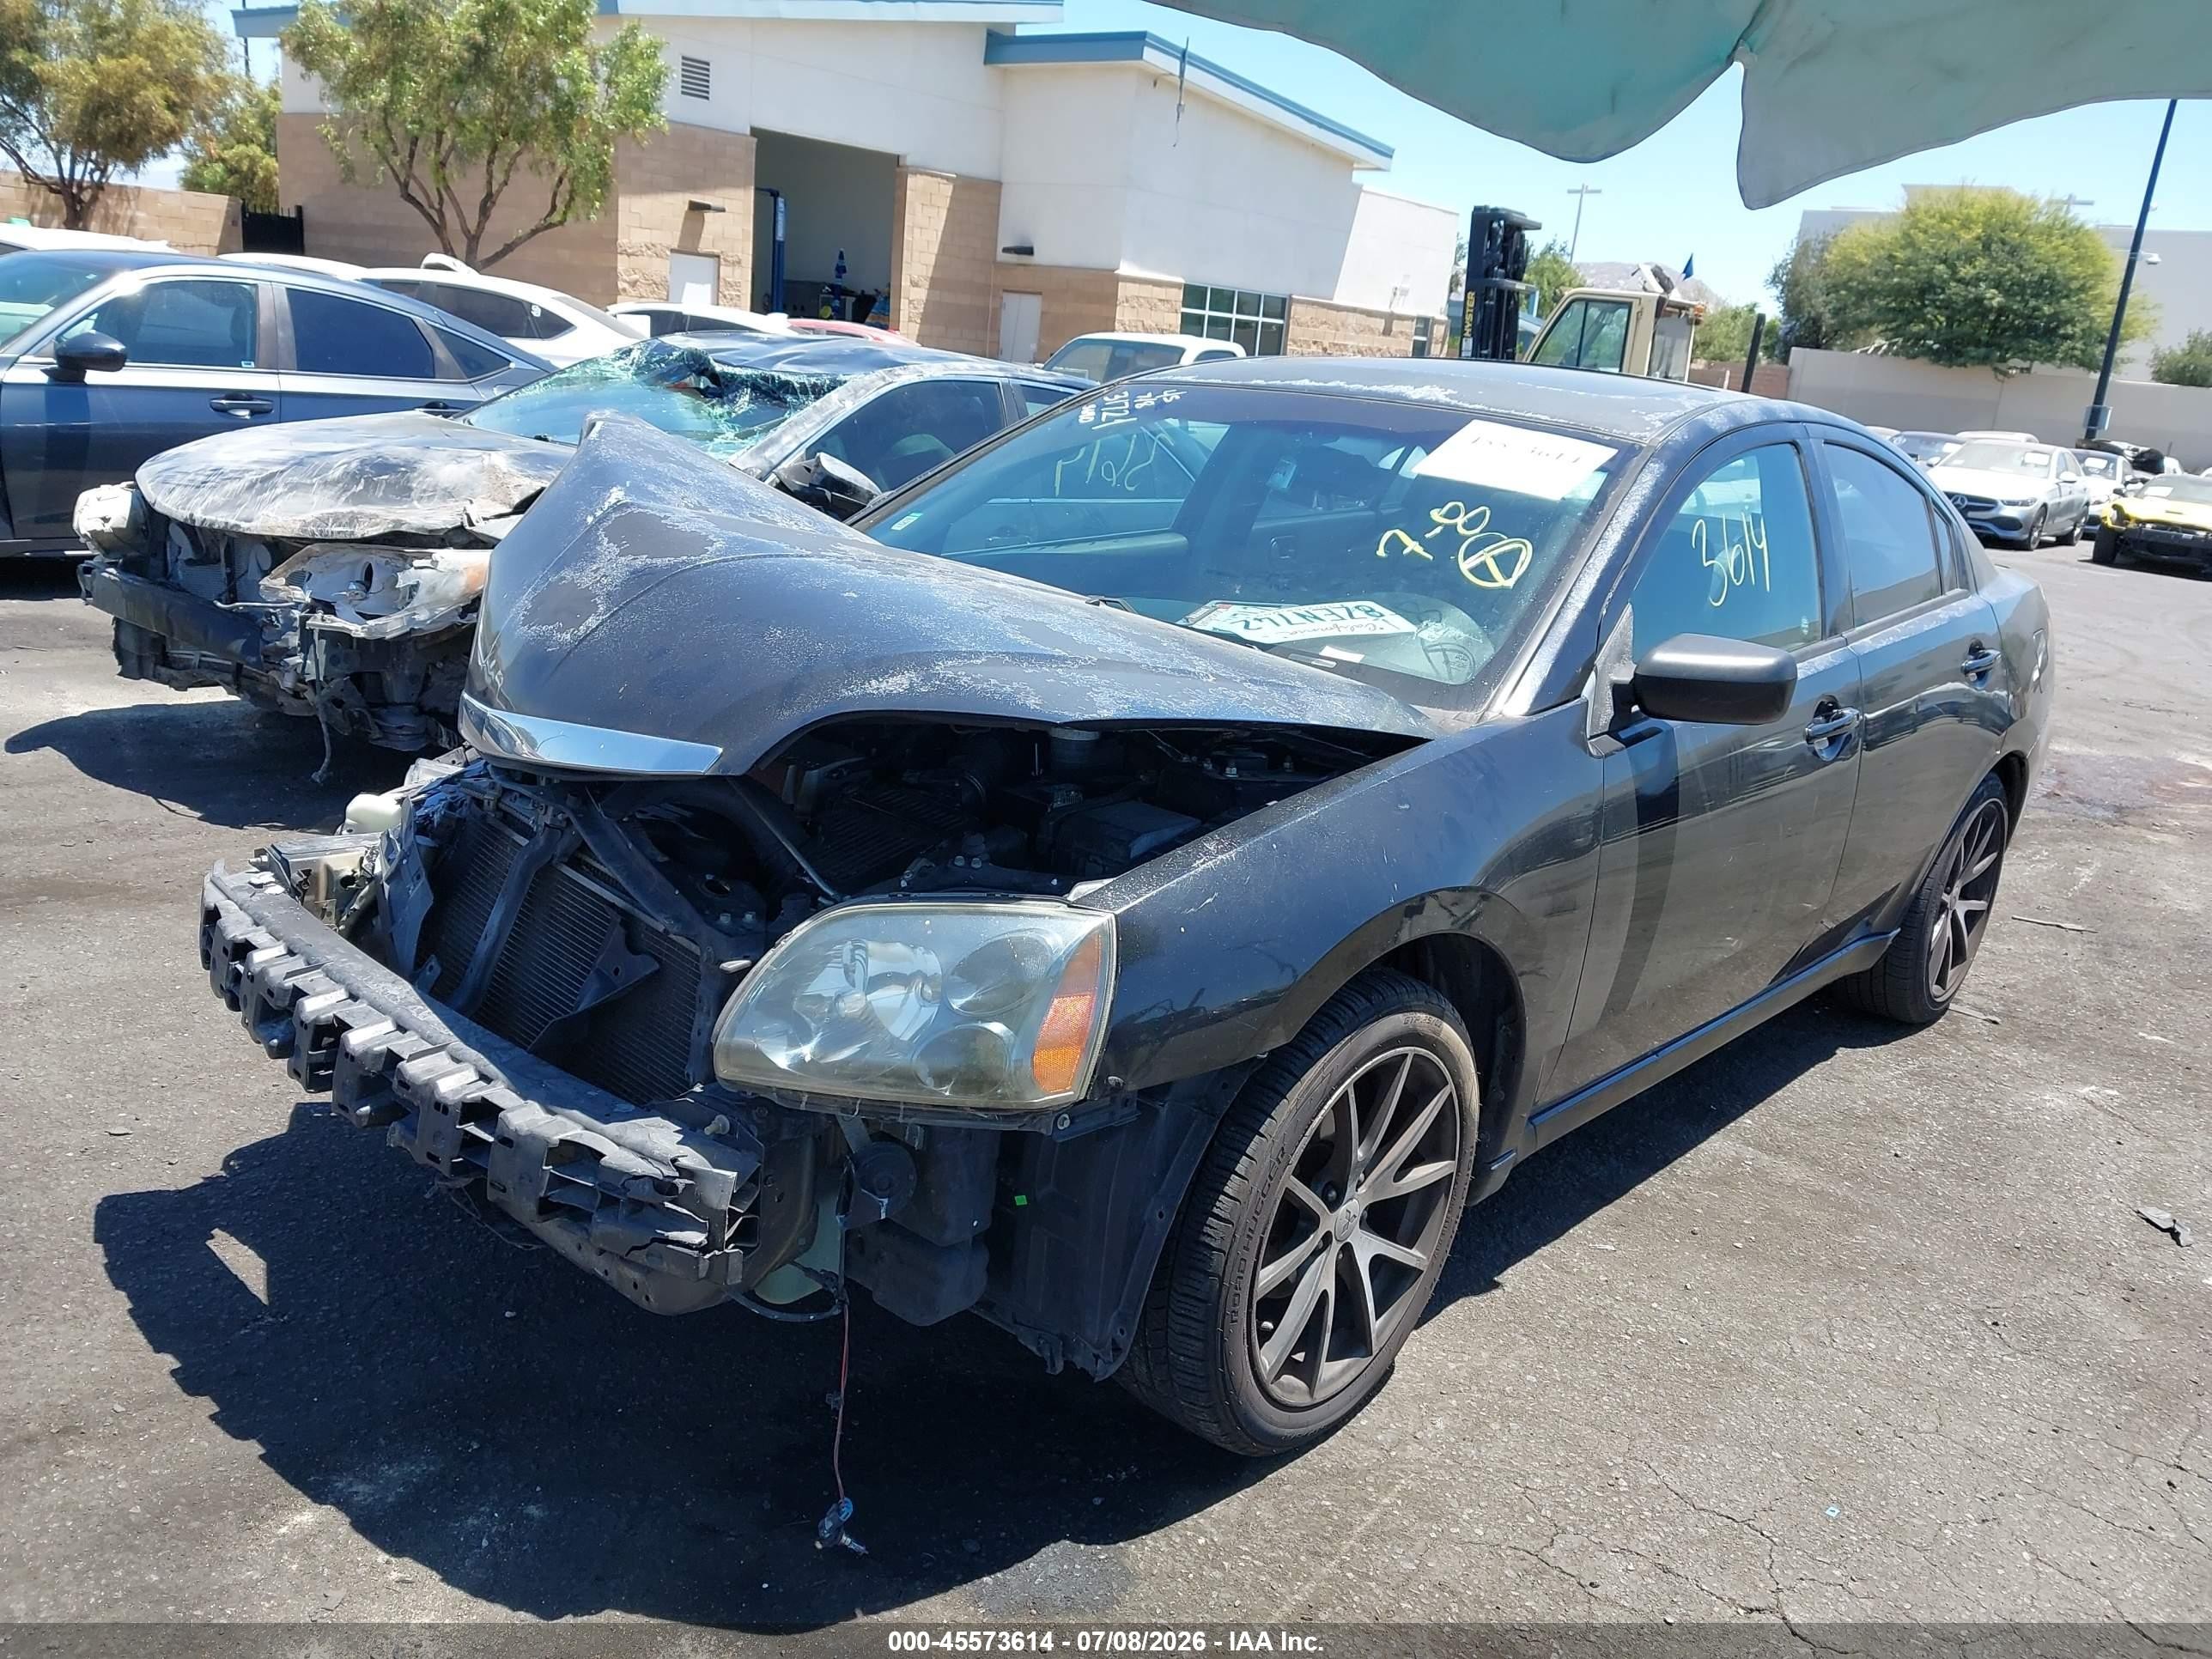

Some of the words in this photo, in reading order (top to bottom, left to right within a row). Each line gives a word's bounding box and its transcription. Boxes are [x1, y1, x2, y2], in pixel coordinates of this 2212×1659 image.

[1692, 512, 1771, 606] 3614
[1230, 1257, 1247, 1324] ROAD
[1243, 1146, 1285, 1252] HUGGER
